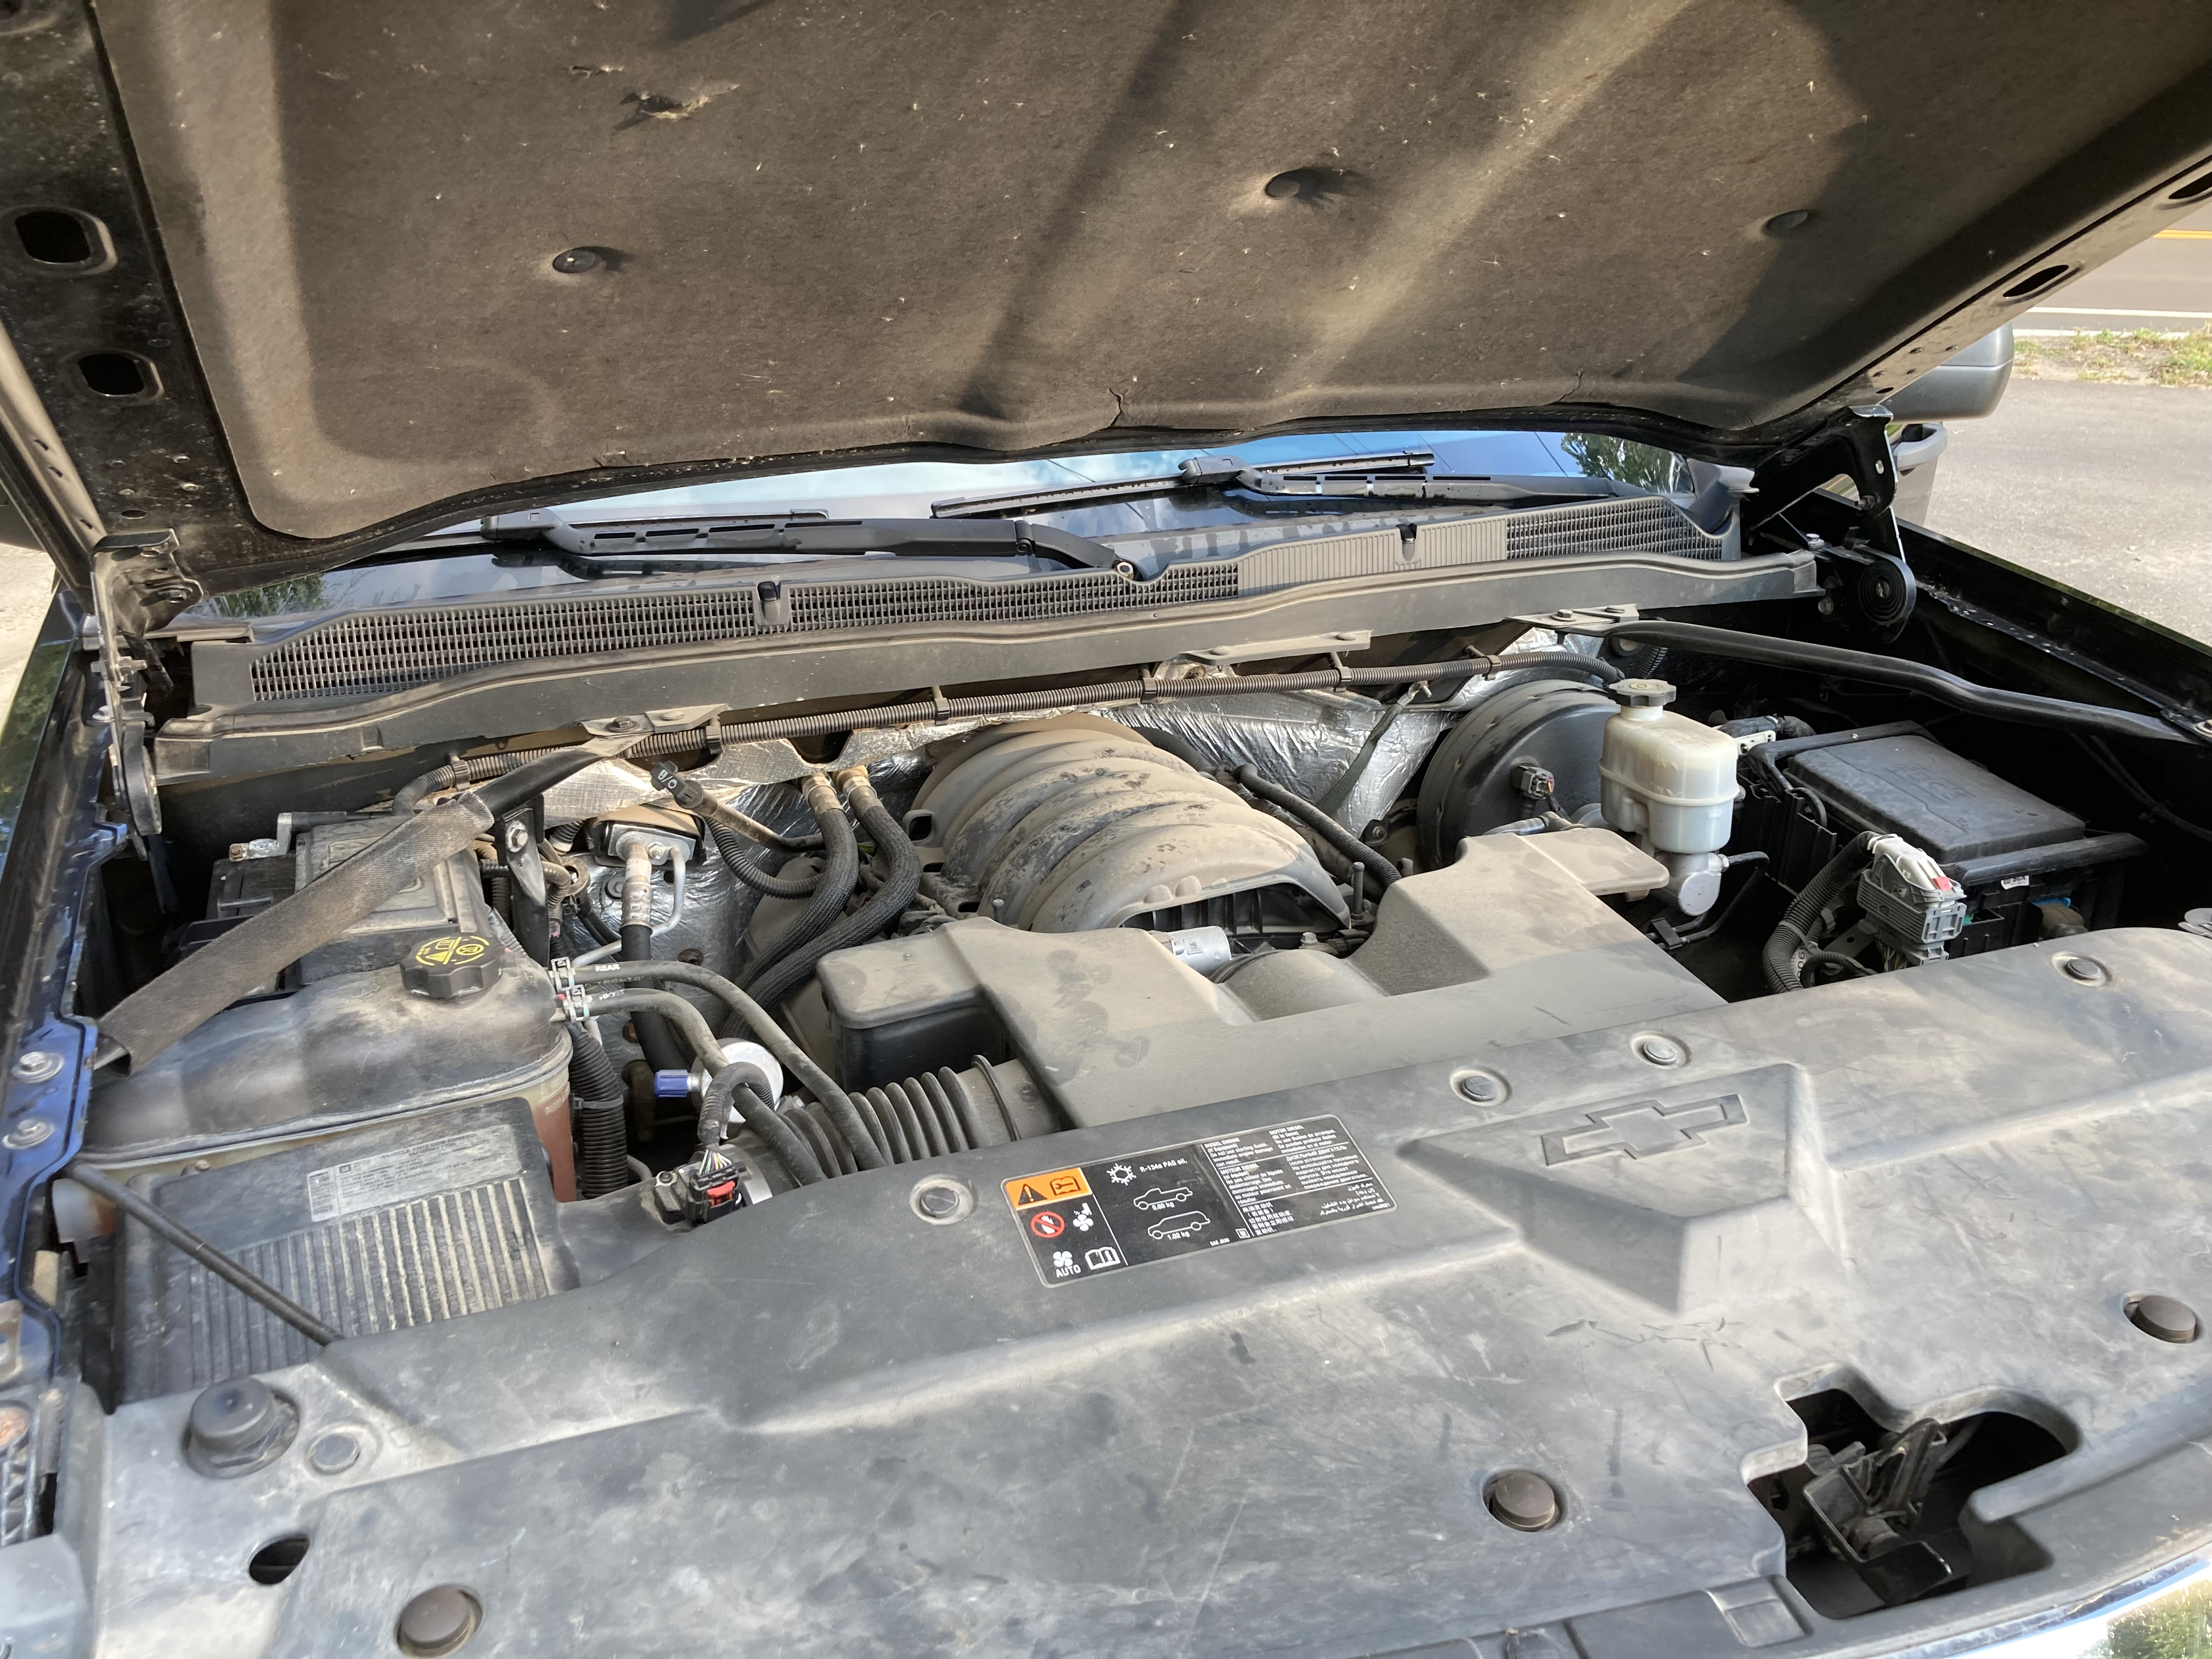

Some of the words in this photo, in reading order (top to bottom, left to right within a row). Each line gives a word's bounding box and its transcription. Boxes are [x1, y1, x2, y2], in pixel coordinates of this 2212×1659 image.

[595, 963, 620, 972] REAR
[1140, 1164, 1163, 1172] R-134a
[1056, 1264, 1081, 1278] AUTO
